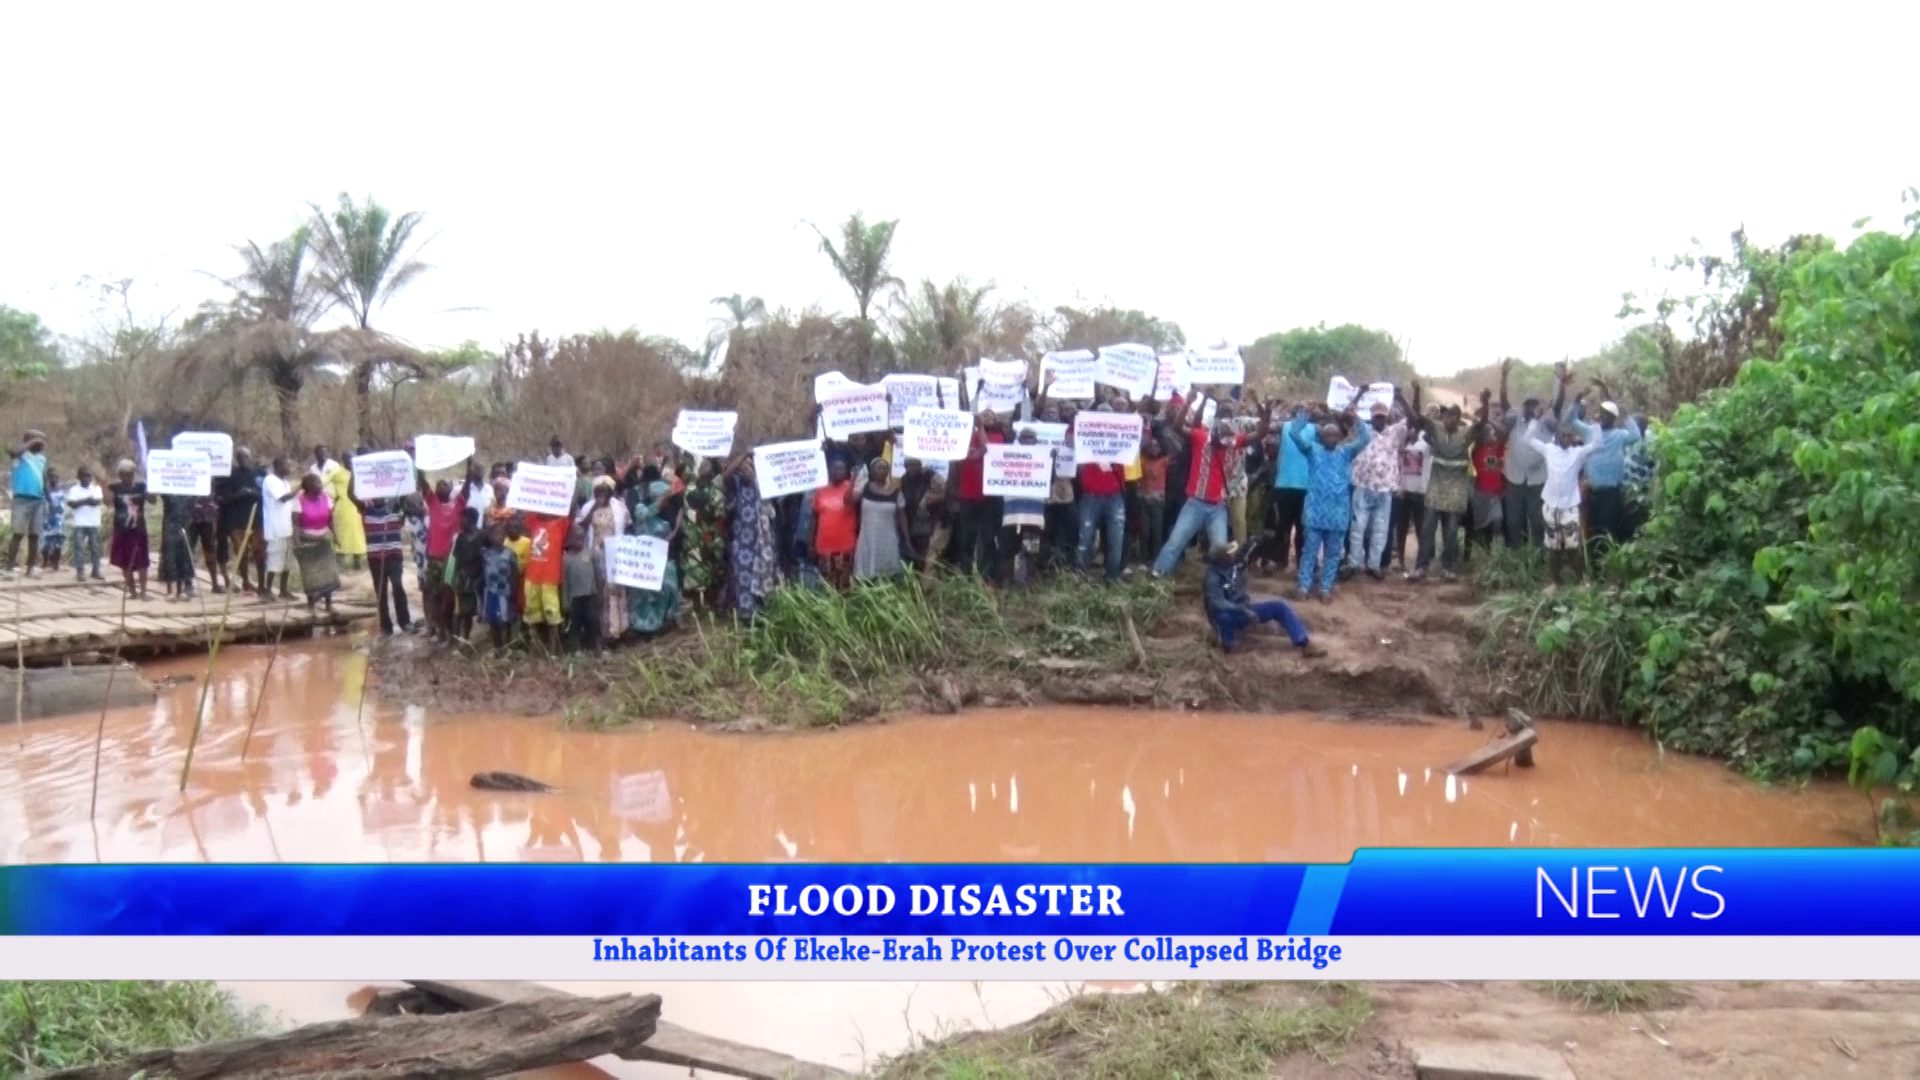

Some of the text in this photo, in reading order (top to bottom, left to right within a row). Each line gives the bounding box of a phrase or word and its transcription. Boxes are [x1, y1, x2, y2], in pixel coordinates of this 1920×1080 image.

[823, 393, 884, 406] GOVERNOR
[921, 411, 958, 420] FLOOD
[909, 419, 969, 429] RECOVERY
[917, 436, 958, 445] HUMAN
[1002, 451, 1033, 460] BRING
[1003, 470, 1032, 478] RIVER
